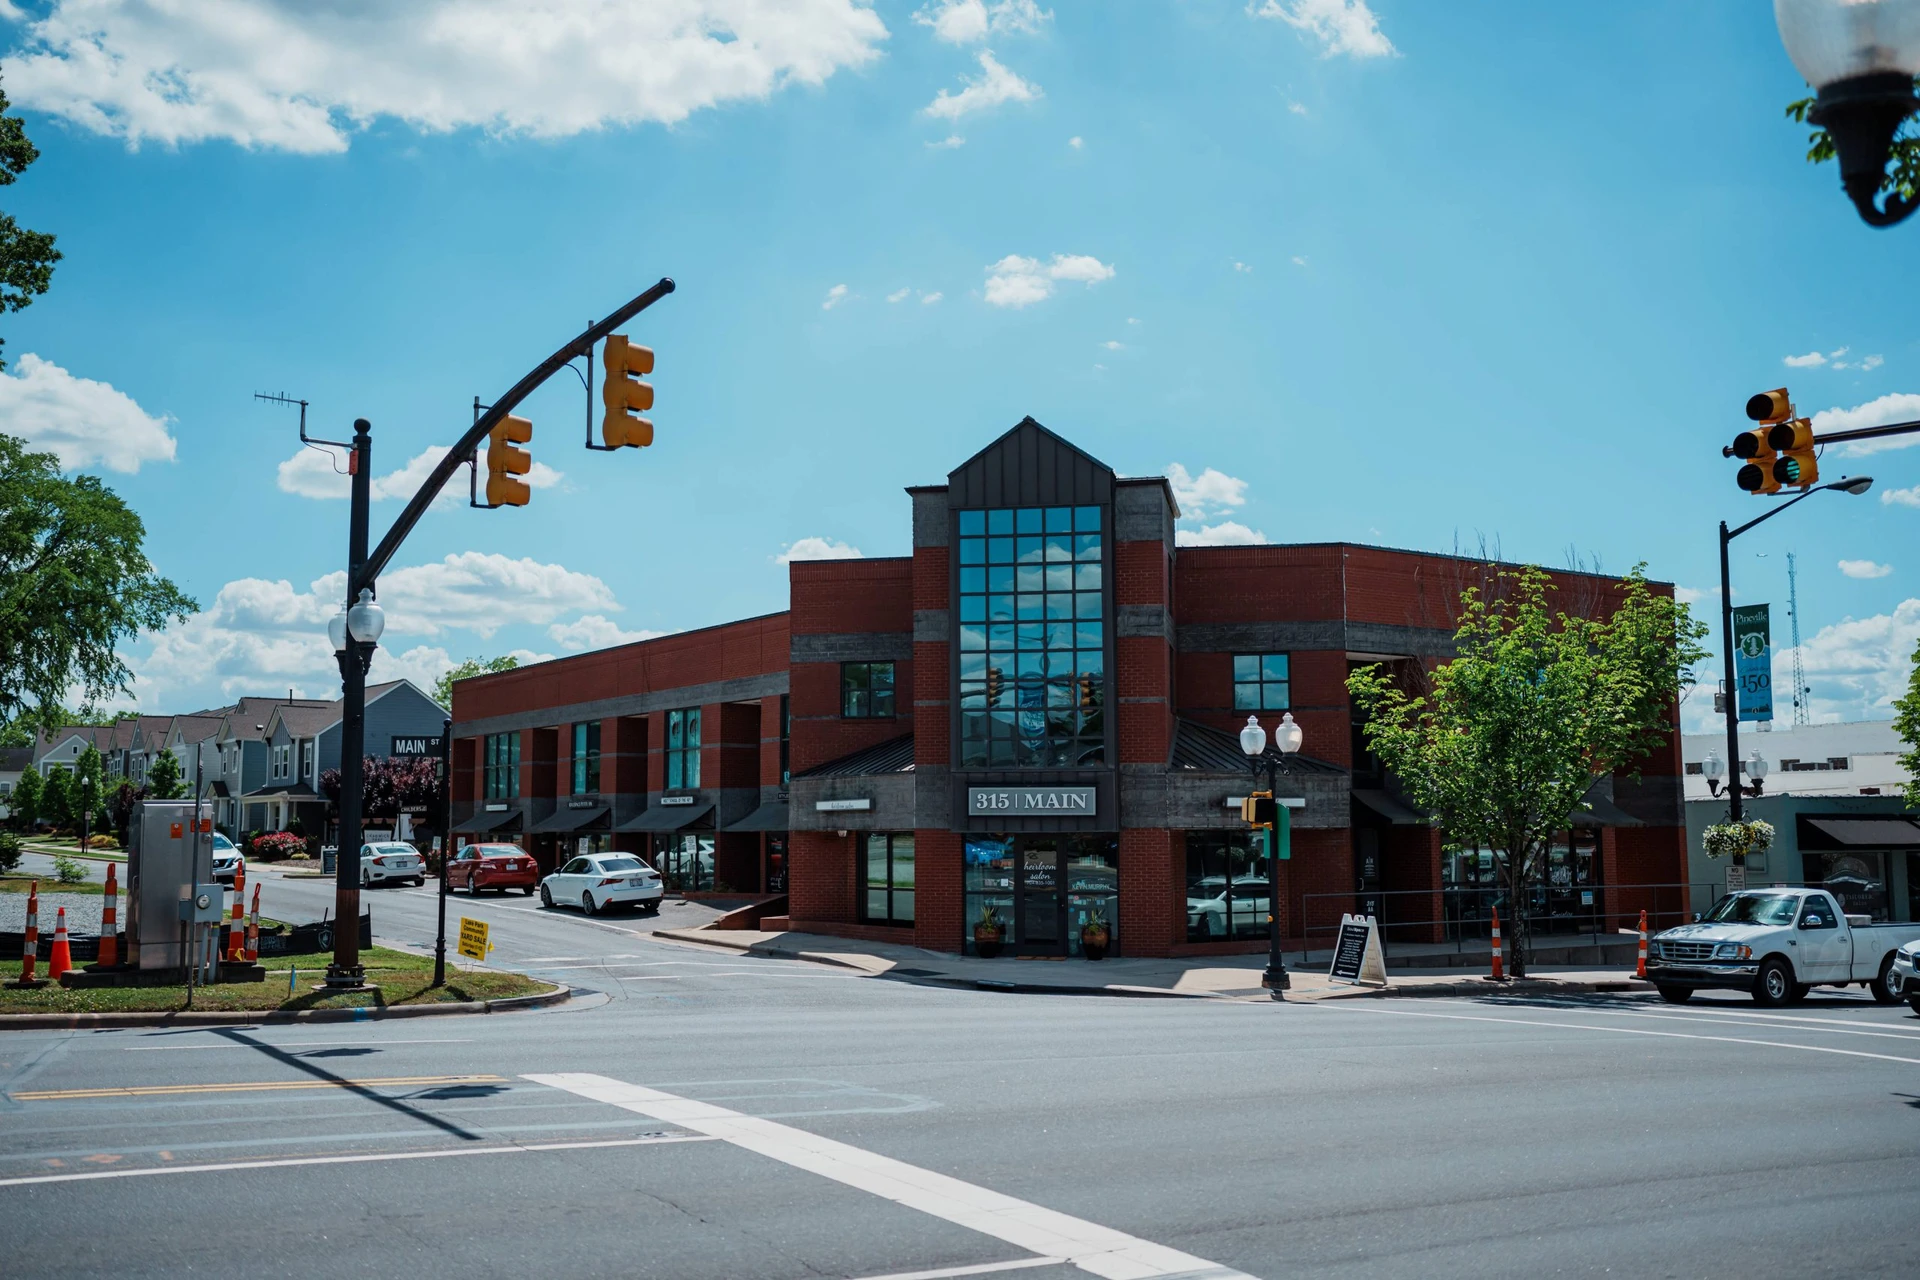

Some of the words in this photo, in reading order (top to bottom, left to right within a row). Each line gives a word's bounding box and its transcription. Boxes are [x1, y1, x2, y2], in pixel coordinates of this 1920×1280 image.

[1736, 612, 1767, 624] Pineville
[1741, 674, 1769, 693] 150
[396, 740, 425, 753] MAIN
[976, 793, 1009, 809] 315
[1024, 793, 1087, 809] MAIN
[1024, 861, 1056, 870] heirloom
[1030, 871, 1051, 880] salon
[461, 932, 473, 941] YARD
[474, 935, 486, 945] SALE
